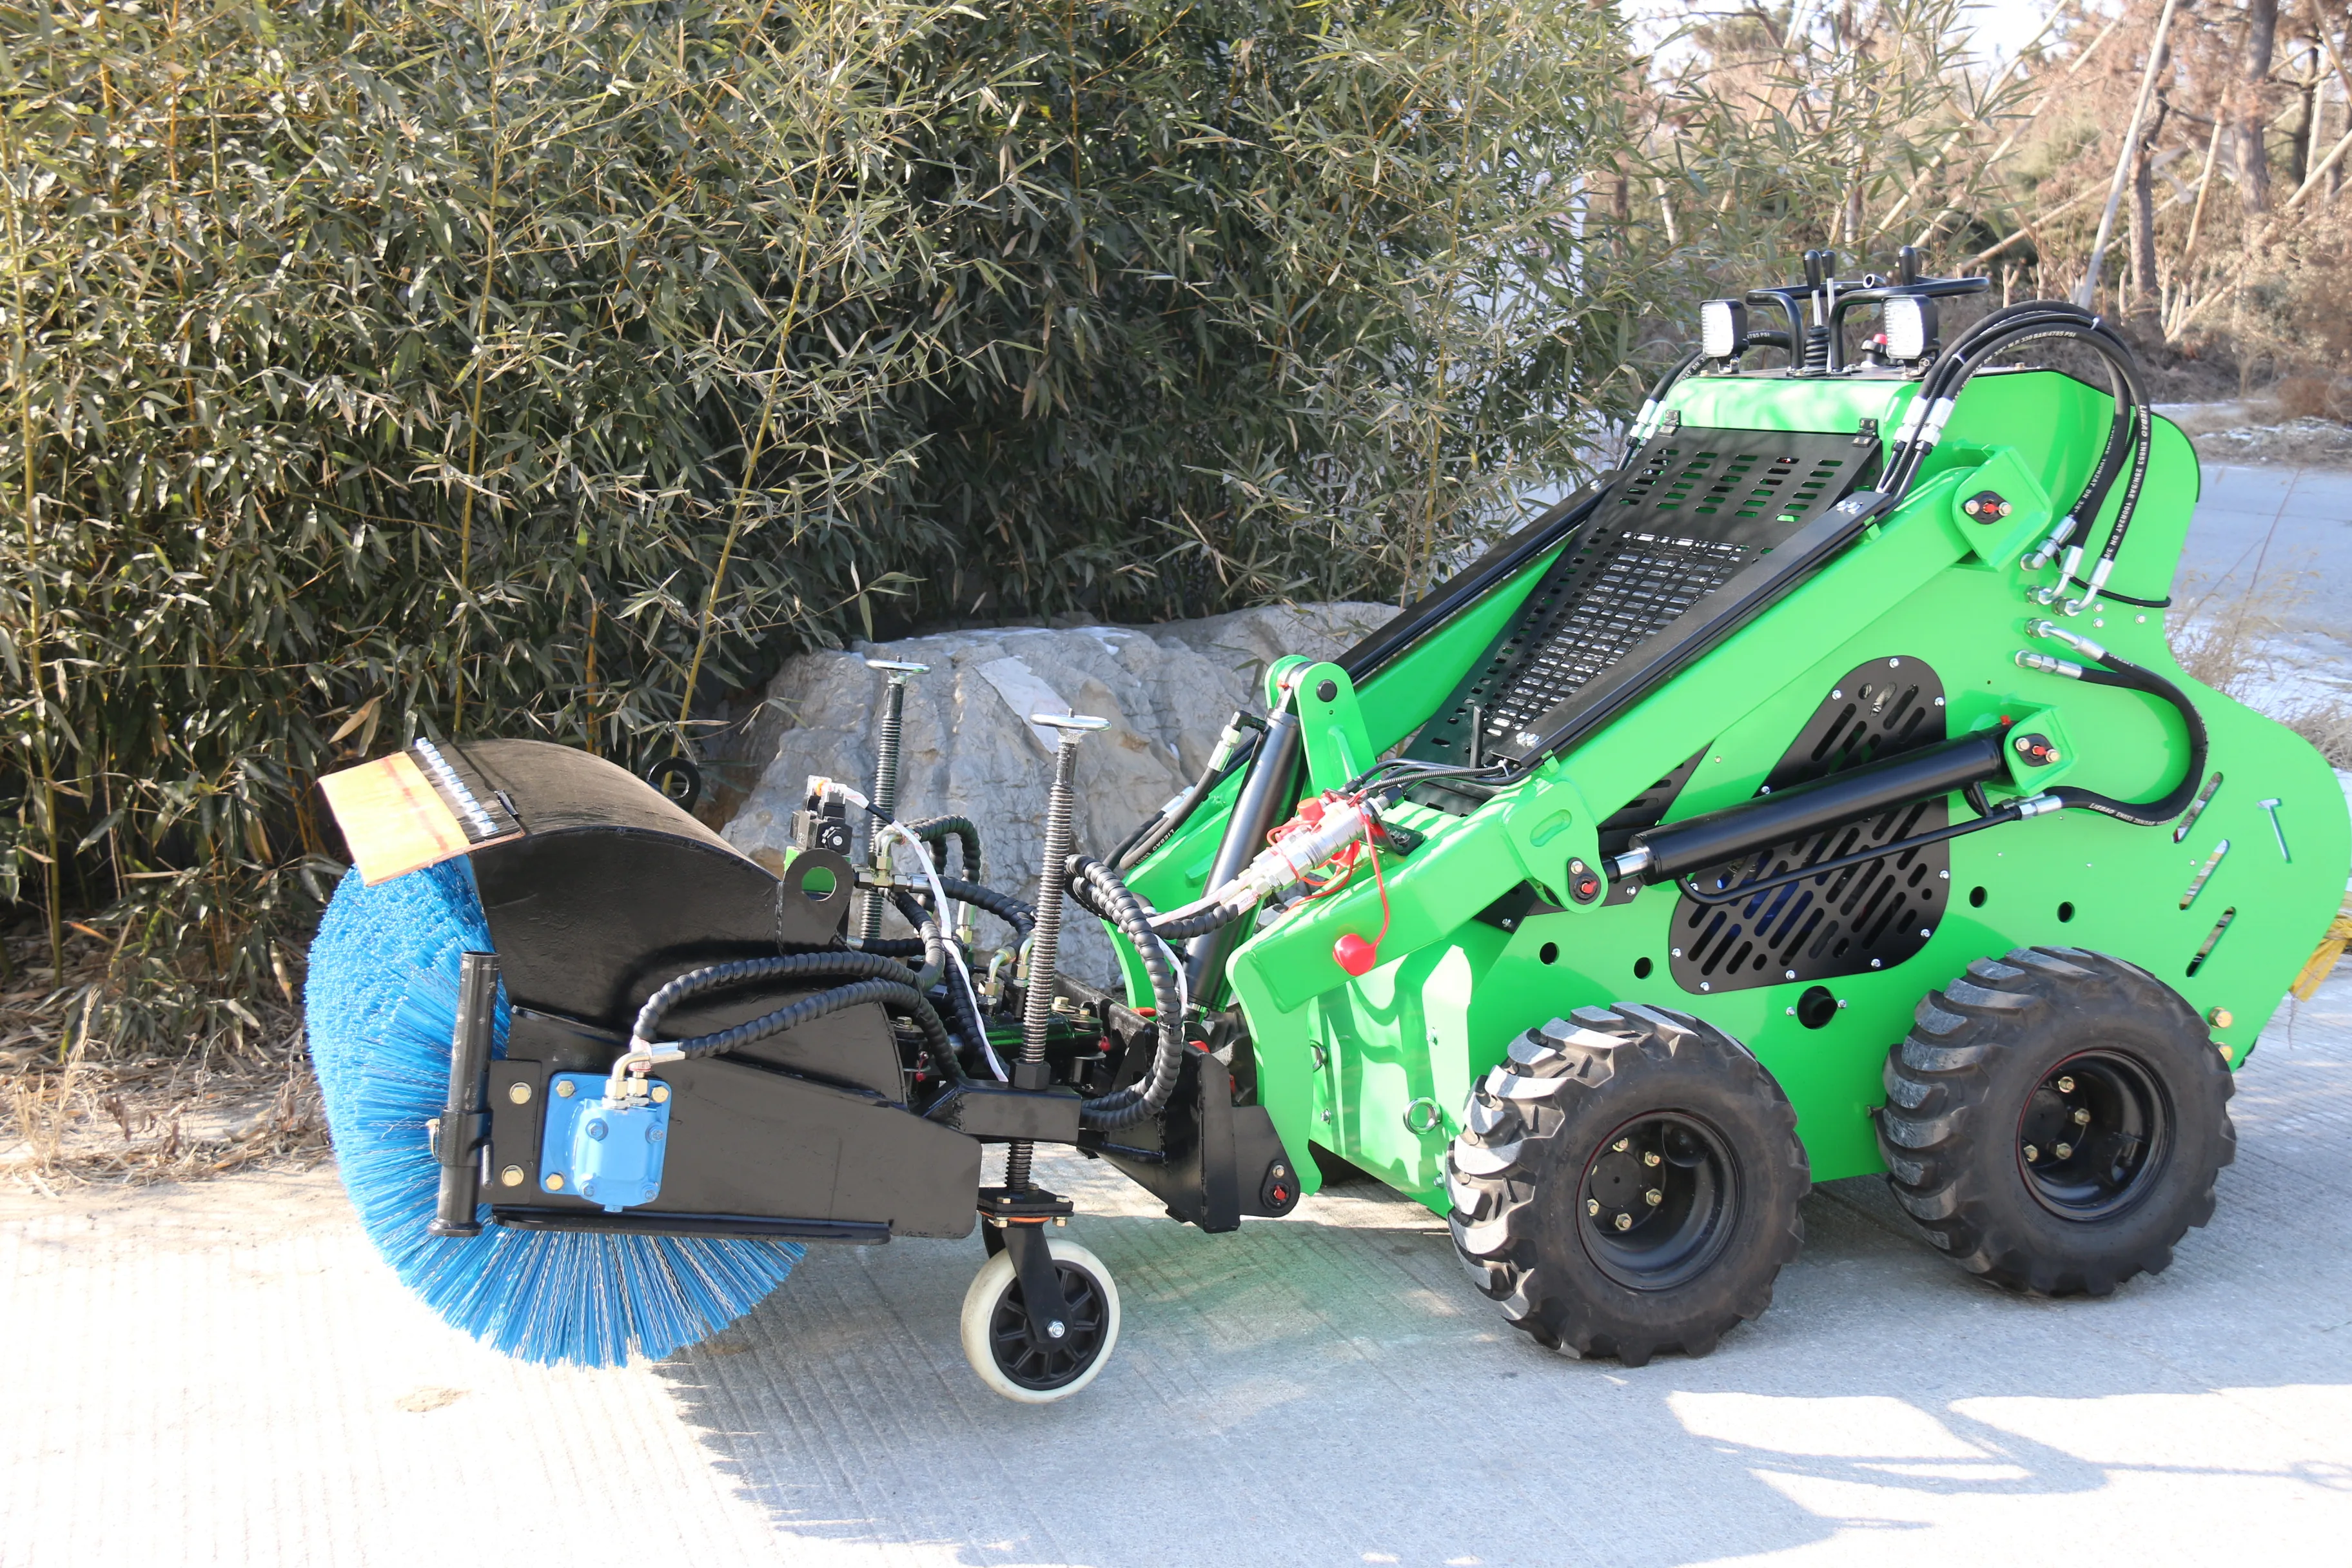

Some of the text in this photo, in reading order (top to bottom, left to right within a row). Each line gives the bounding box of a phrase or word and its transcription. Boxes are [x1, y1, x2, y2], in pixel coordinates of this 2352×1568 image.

[2139, 404, 2148, 437] LIEBAO
[2137, 441, 2147, 465] EN853
[2127, 467, 2142, 499] 2SN/SAE
[2115, 502, 2132, 533] 100R2AT
[2110, 534, 2119, 545] DN
[2088, 803, 2116, 814] LIEBAO
[1152, 828, 1175, 851] LIEBAO
